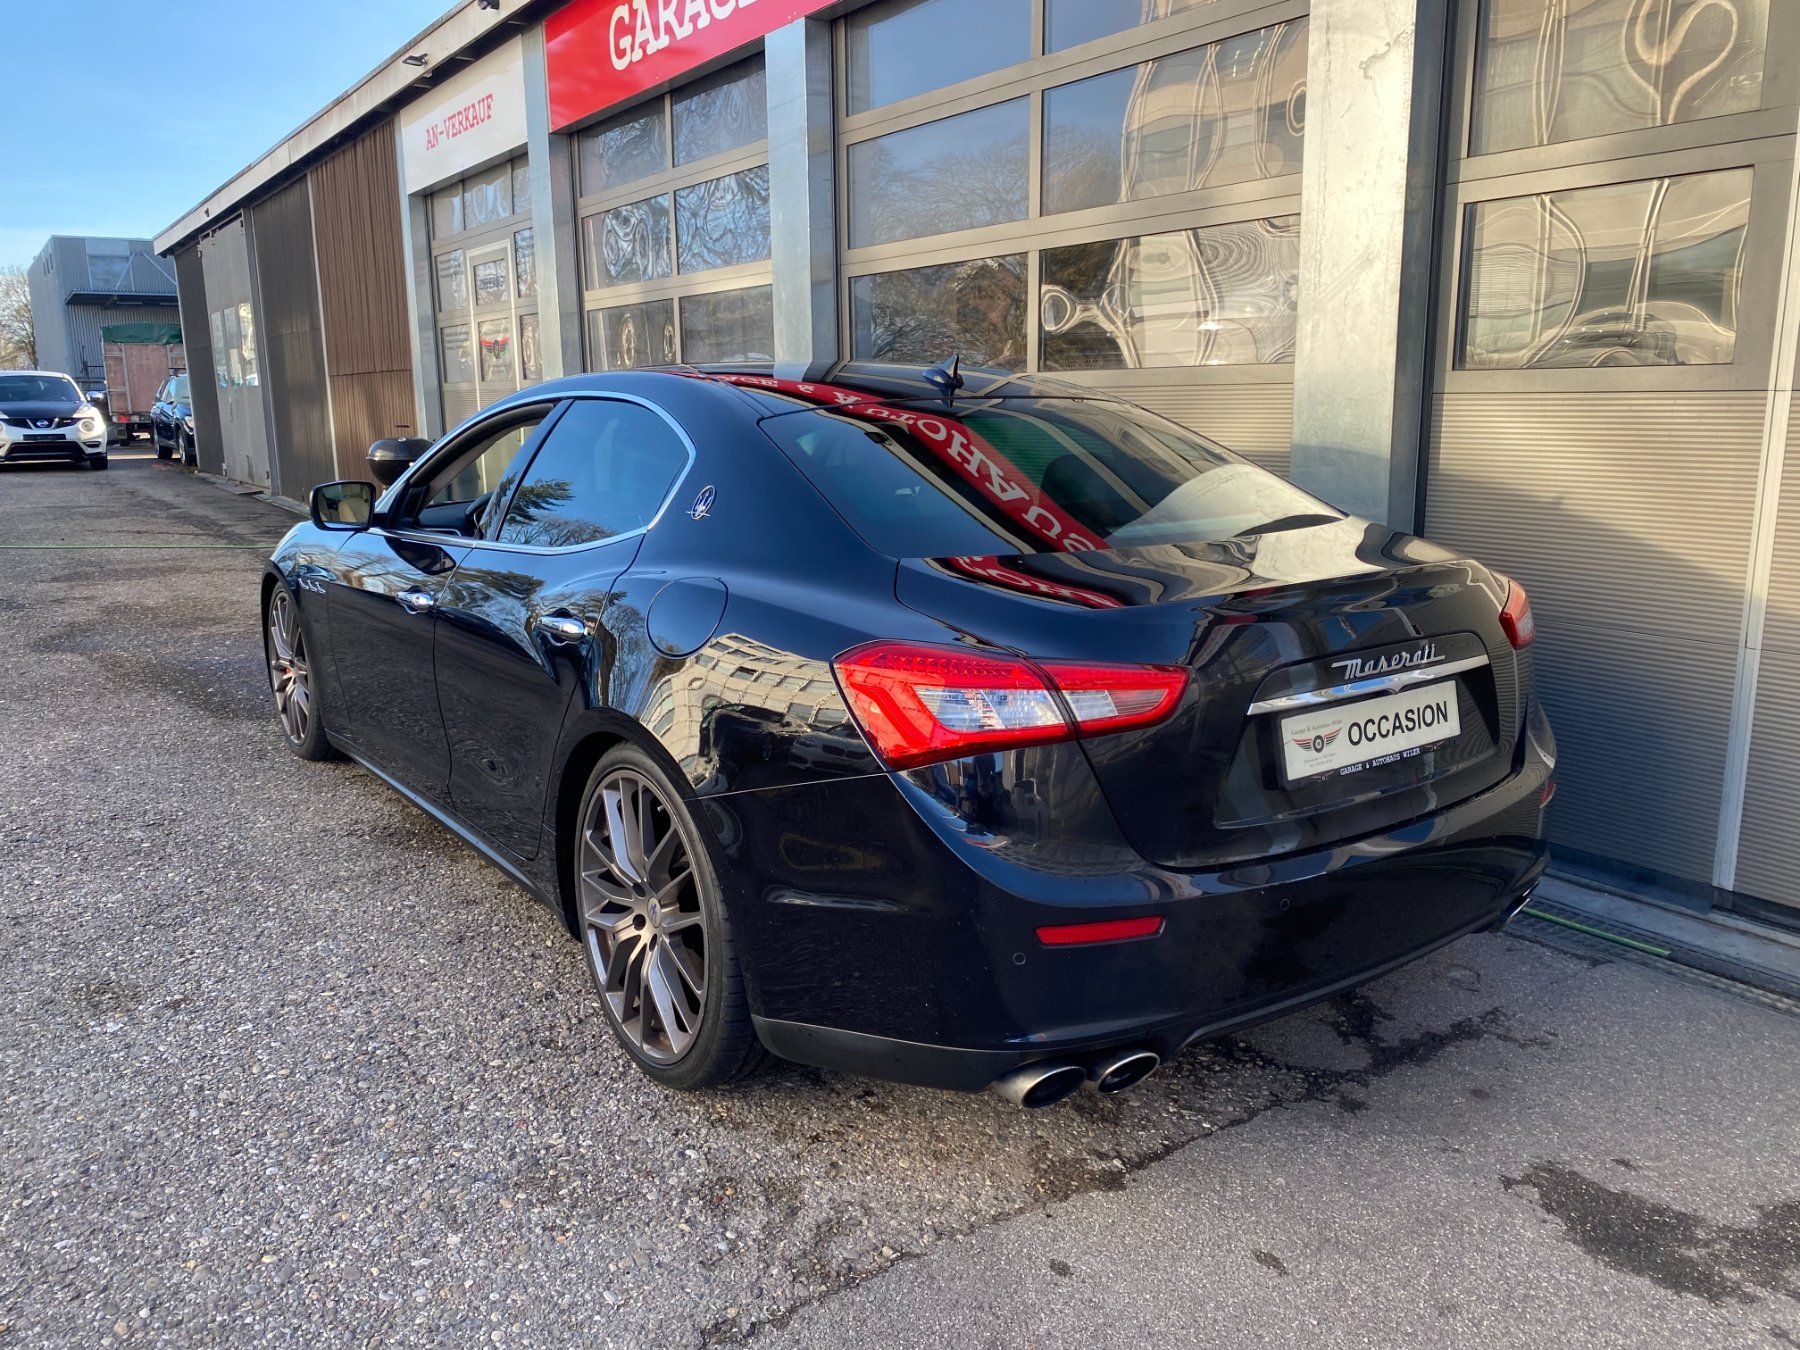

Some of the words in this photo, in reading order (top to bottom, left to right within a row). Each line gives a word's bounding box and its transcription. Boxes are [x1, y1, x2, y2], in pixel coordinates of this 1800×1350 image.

[609, 0, 757, 70] GARA
[426, 93, 493, 151] AN-VERKAUF
[1331, 643, 1445, 680] Maserati
[1347, 701, 1449, 746] OCCASION
[1340, 763, 1363, 776] GARAGE
[1372, 753, 1401, 767] AUTOHAUS
[1402, 747, 1421, 759] WILER
